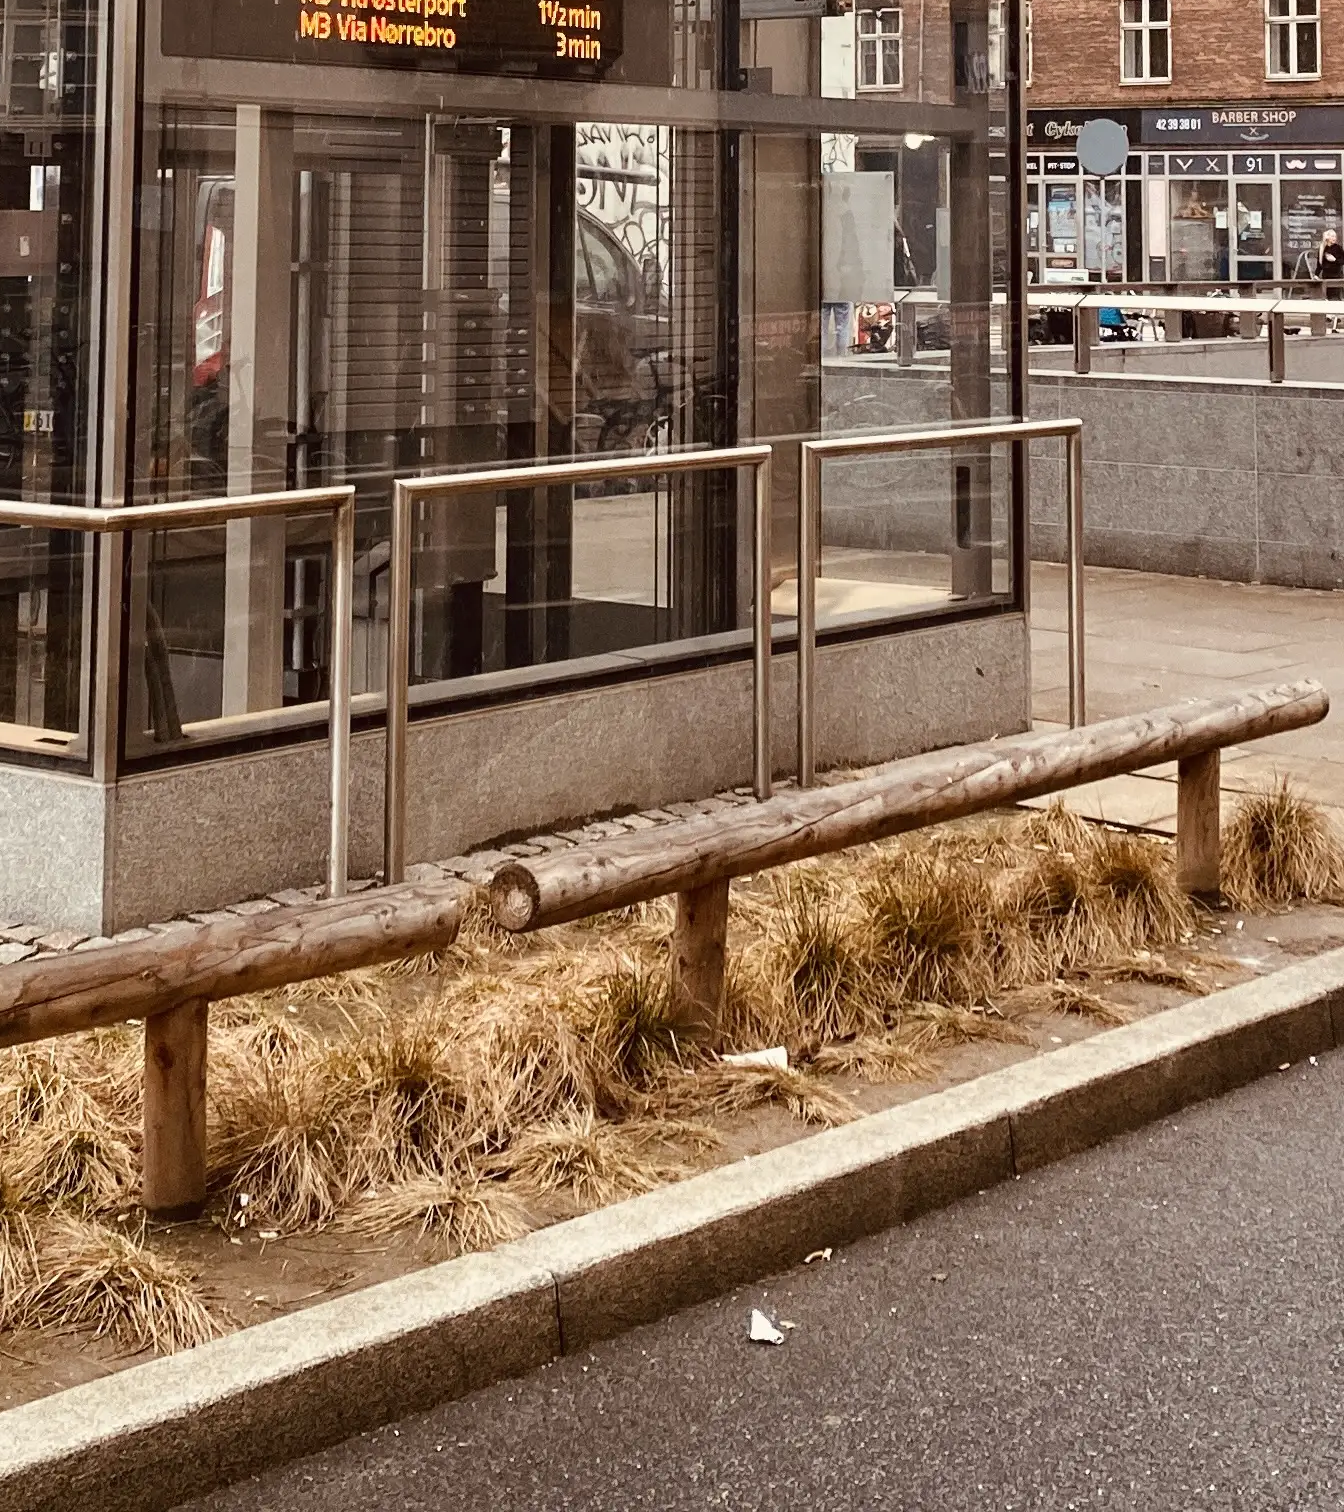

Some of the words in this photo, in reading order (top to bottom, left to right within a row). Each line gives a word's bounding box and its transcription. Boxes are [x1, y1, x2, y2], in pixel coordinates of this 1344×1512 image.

[569, 4, 601, 30] min
[300, 10, 332, 39] M3
[336, 12, 367, 42] Via
[371, 16, 456, 49] Nørrebro
[556, 31, 567, 57] 3
[569, 34, 601, 60] min
[1212, 111, 1258, 124] BARBER
[1262, 110, 1297, 123] SHOP
[1245, 157, 1263, 172] 91
